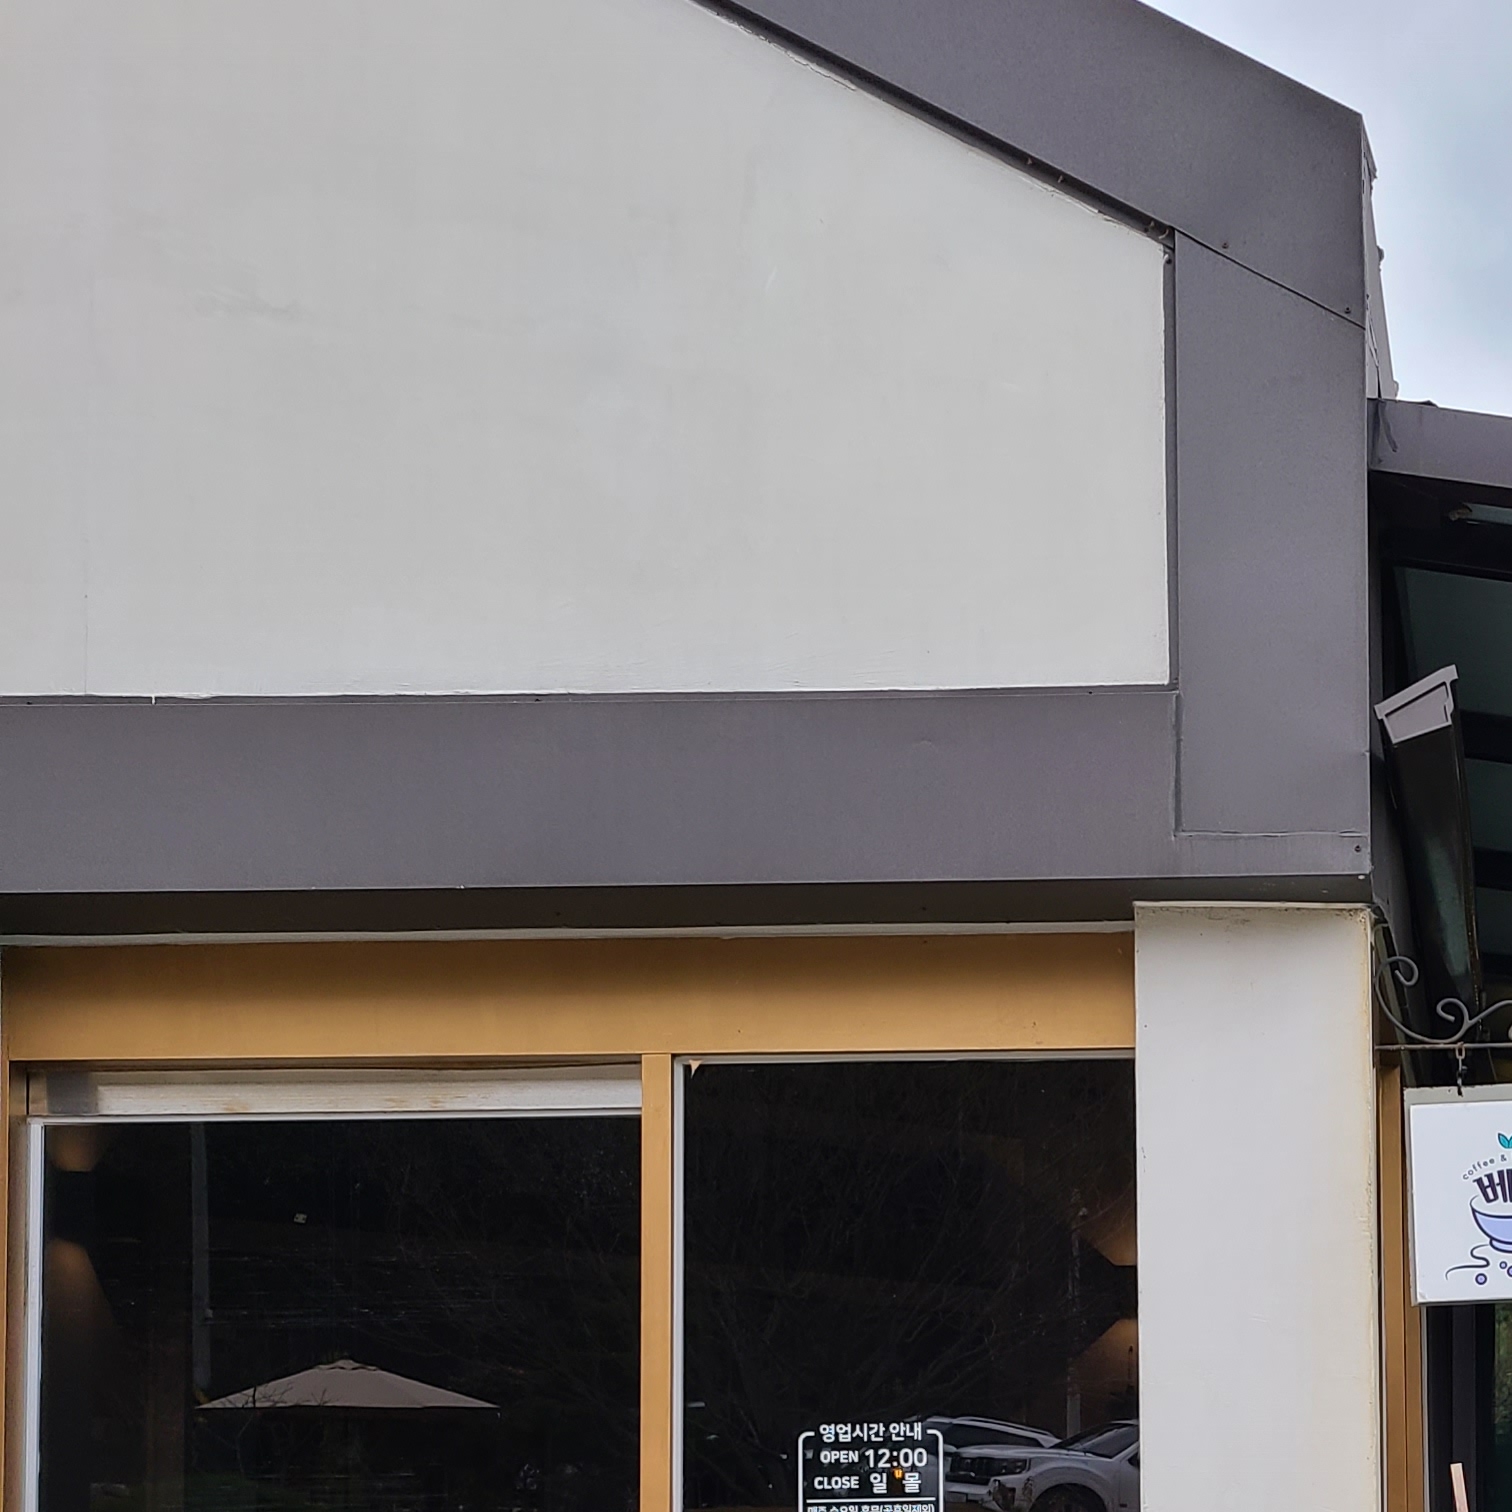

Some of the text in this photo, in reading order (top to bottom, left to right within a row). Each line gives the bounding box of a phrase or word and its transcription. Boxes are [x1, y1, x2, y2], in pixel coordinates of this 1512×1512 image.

[1462, 1158, 1495, 1180] coffee
[1500, 1154, 1507, 1162] &
[819, 1422, 922, 1442] 영업시간 안내
[820, 1447, 928, 1468] OPEN 12:00
[814, 1475, 860, 1490] CLOSE
